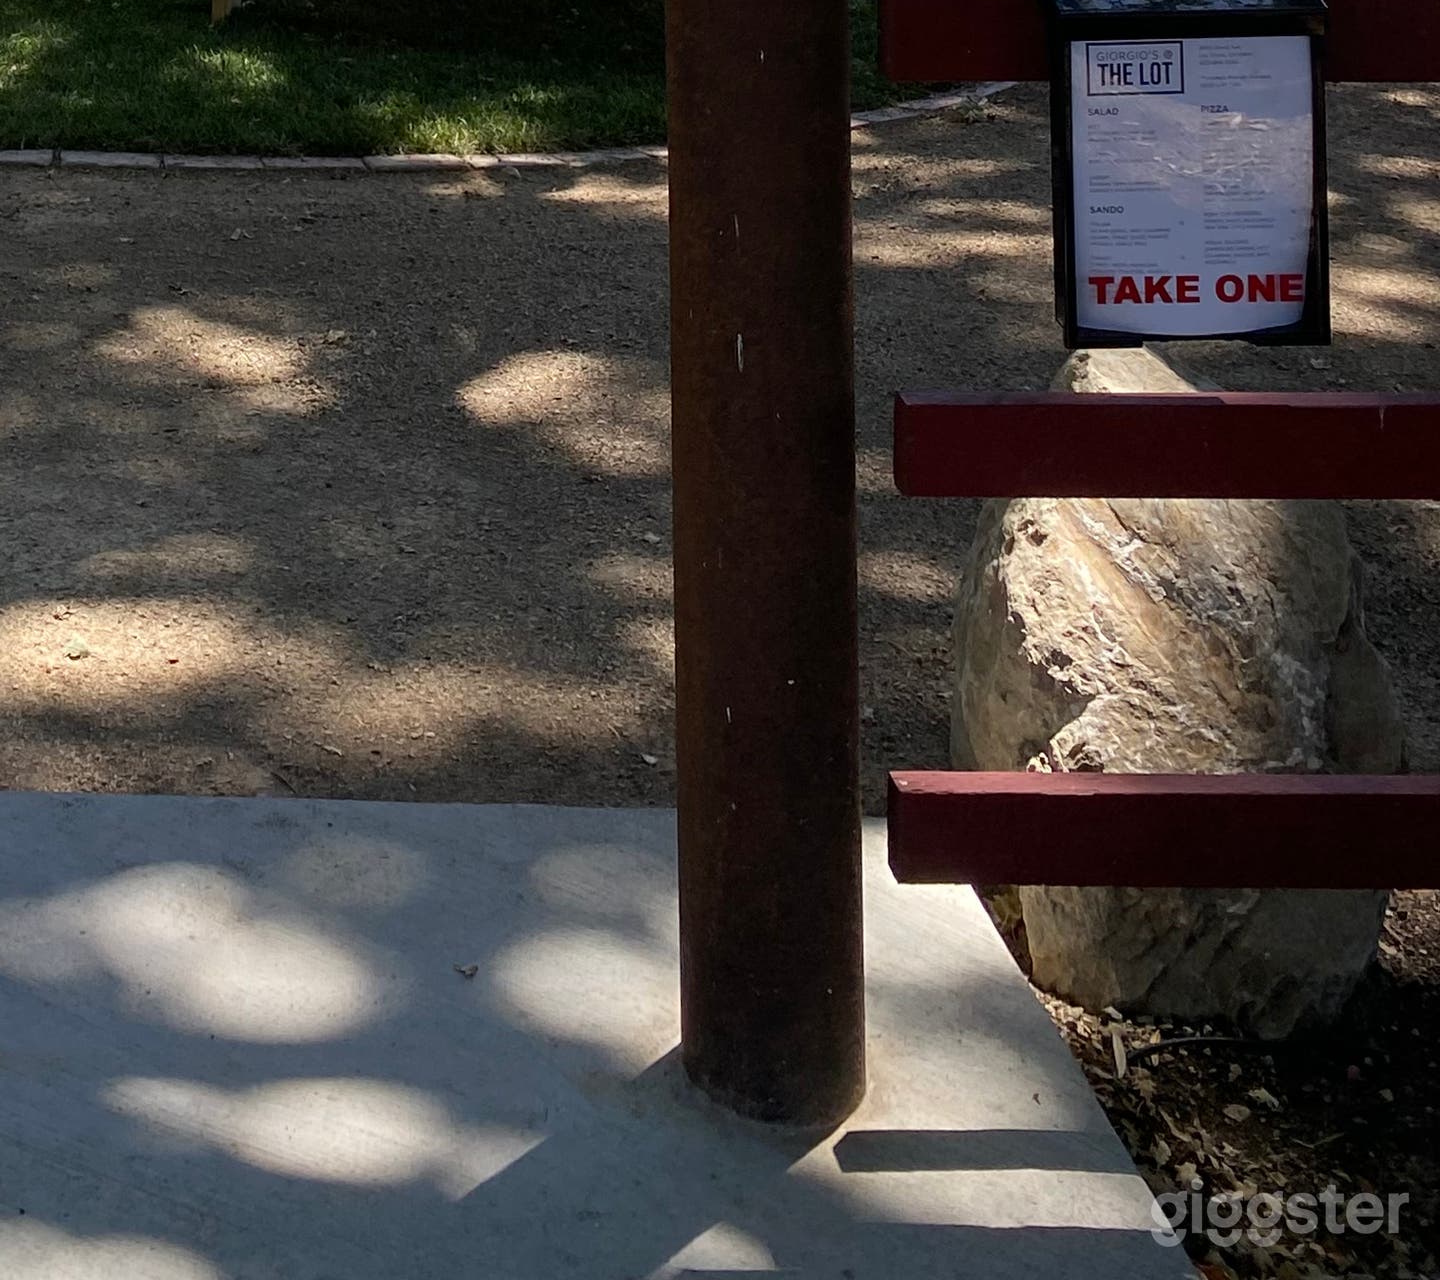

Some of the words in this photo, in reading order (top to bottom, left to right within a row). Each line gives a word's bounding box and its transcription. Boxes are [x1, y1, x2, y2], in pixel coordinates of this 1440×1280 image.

[1096, 49, 1159, 62] GIORGIO'S
[1096, 62, 1134, 87] THE
[1140, 62, 1173, 85] LOT
[1087, 107, 1120, 117] SALAD
[1200, 104, 1230, 114] PIZZA
[1089, 205, 1125, 215] SANDO
[1088, 275, 1201, 305] TAKE
[1215, 274, 1304, 304] ONE
